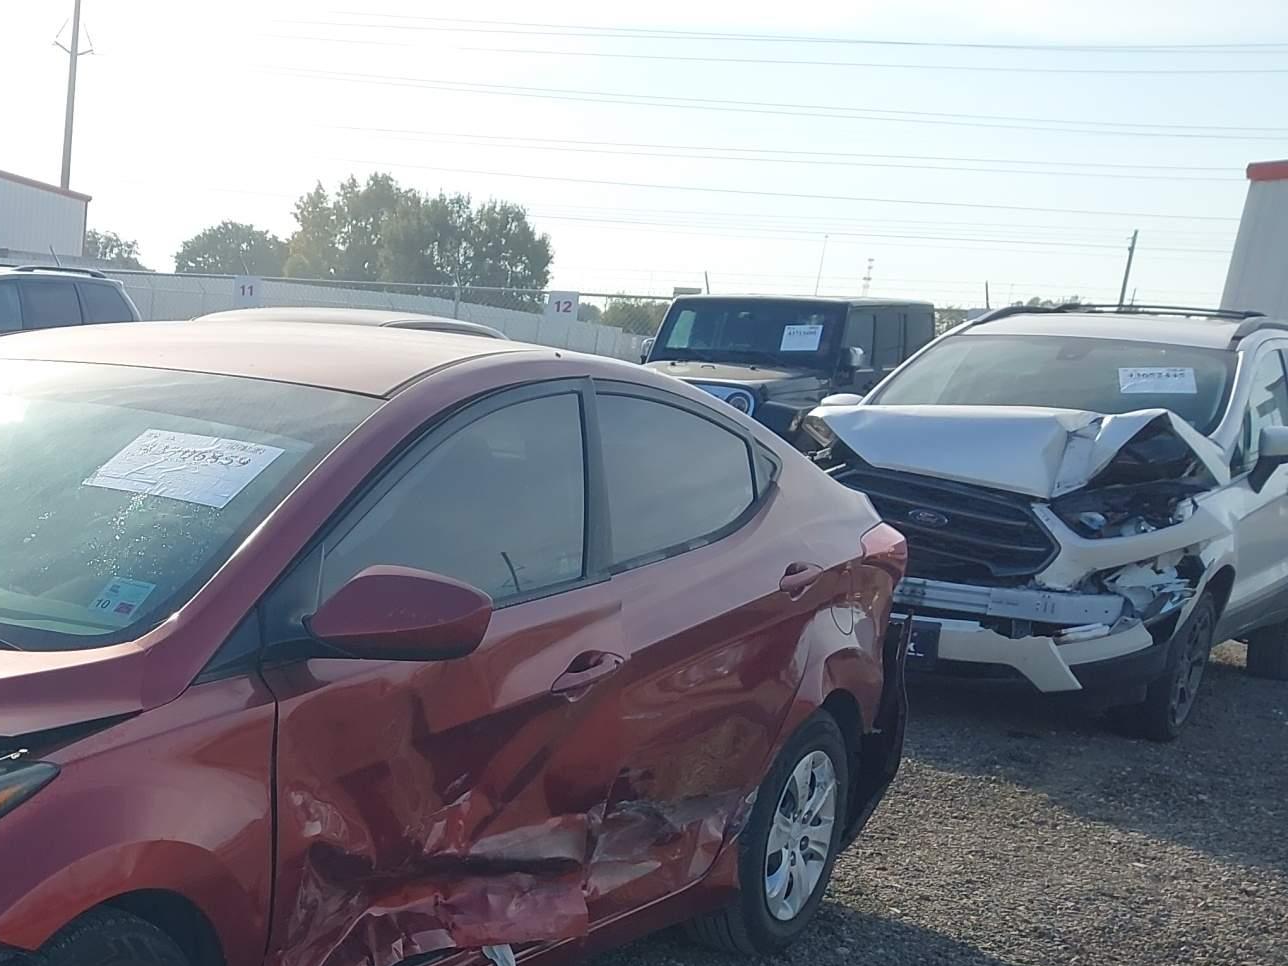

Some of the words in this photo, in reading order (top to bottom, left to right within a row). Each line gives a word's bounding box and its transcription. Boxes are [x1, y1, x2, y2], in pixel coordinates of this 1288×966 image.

[240, 285, 253, 297] 11
[554, 300, 573, 313] 12
[95, 599, 111, 609] 10
